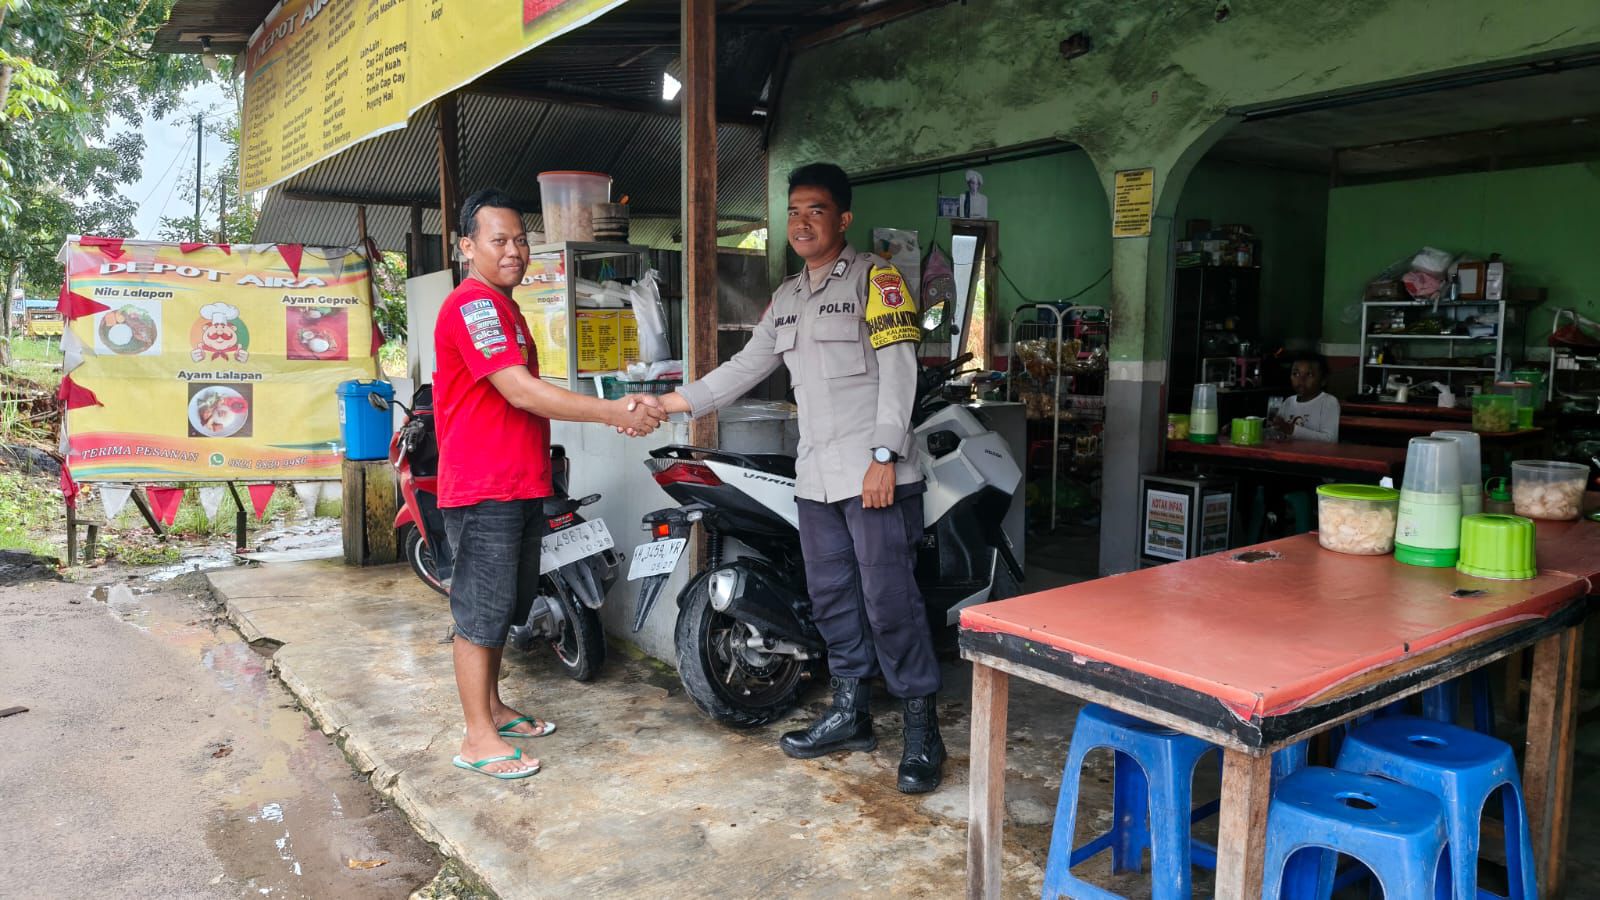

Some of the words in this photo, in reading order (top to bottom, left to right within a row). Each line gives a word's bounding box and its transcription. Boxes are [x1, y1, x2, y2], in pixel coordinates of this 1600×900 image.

[384, 40, 408, 57] Goreng
[384, 57, 402, 72] Kuah
[393, 72, 406, 84] Cay
[99, 262, 231, 282] DEPOT
[237, 274, 327, 289] AIRA
[94, 287, 120, 298] Nila
[123, 288, 174, 300] Lalapan
[282, 295, 315, 306] Ayam
[318, 294, 359, 306] Geprek
[474, 300, 492, 309] TIM
[819, 303, 855, 315] POLRI
[178, 370, 212, 382] Ayam
[215, 370, 263, 383] Lalapan
[81, 446, 132, 460] TERIMA
[136, 446, 199, 462] PESANAN
[1151, 498, 1168, 509] KOTAK
[1169, 500, 1183, 512] INFAQ
